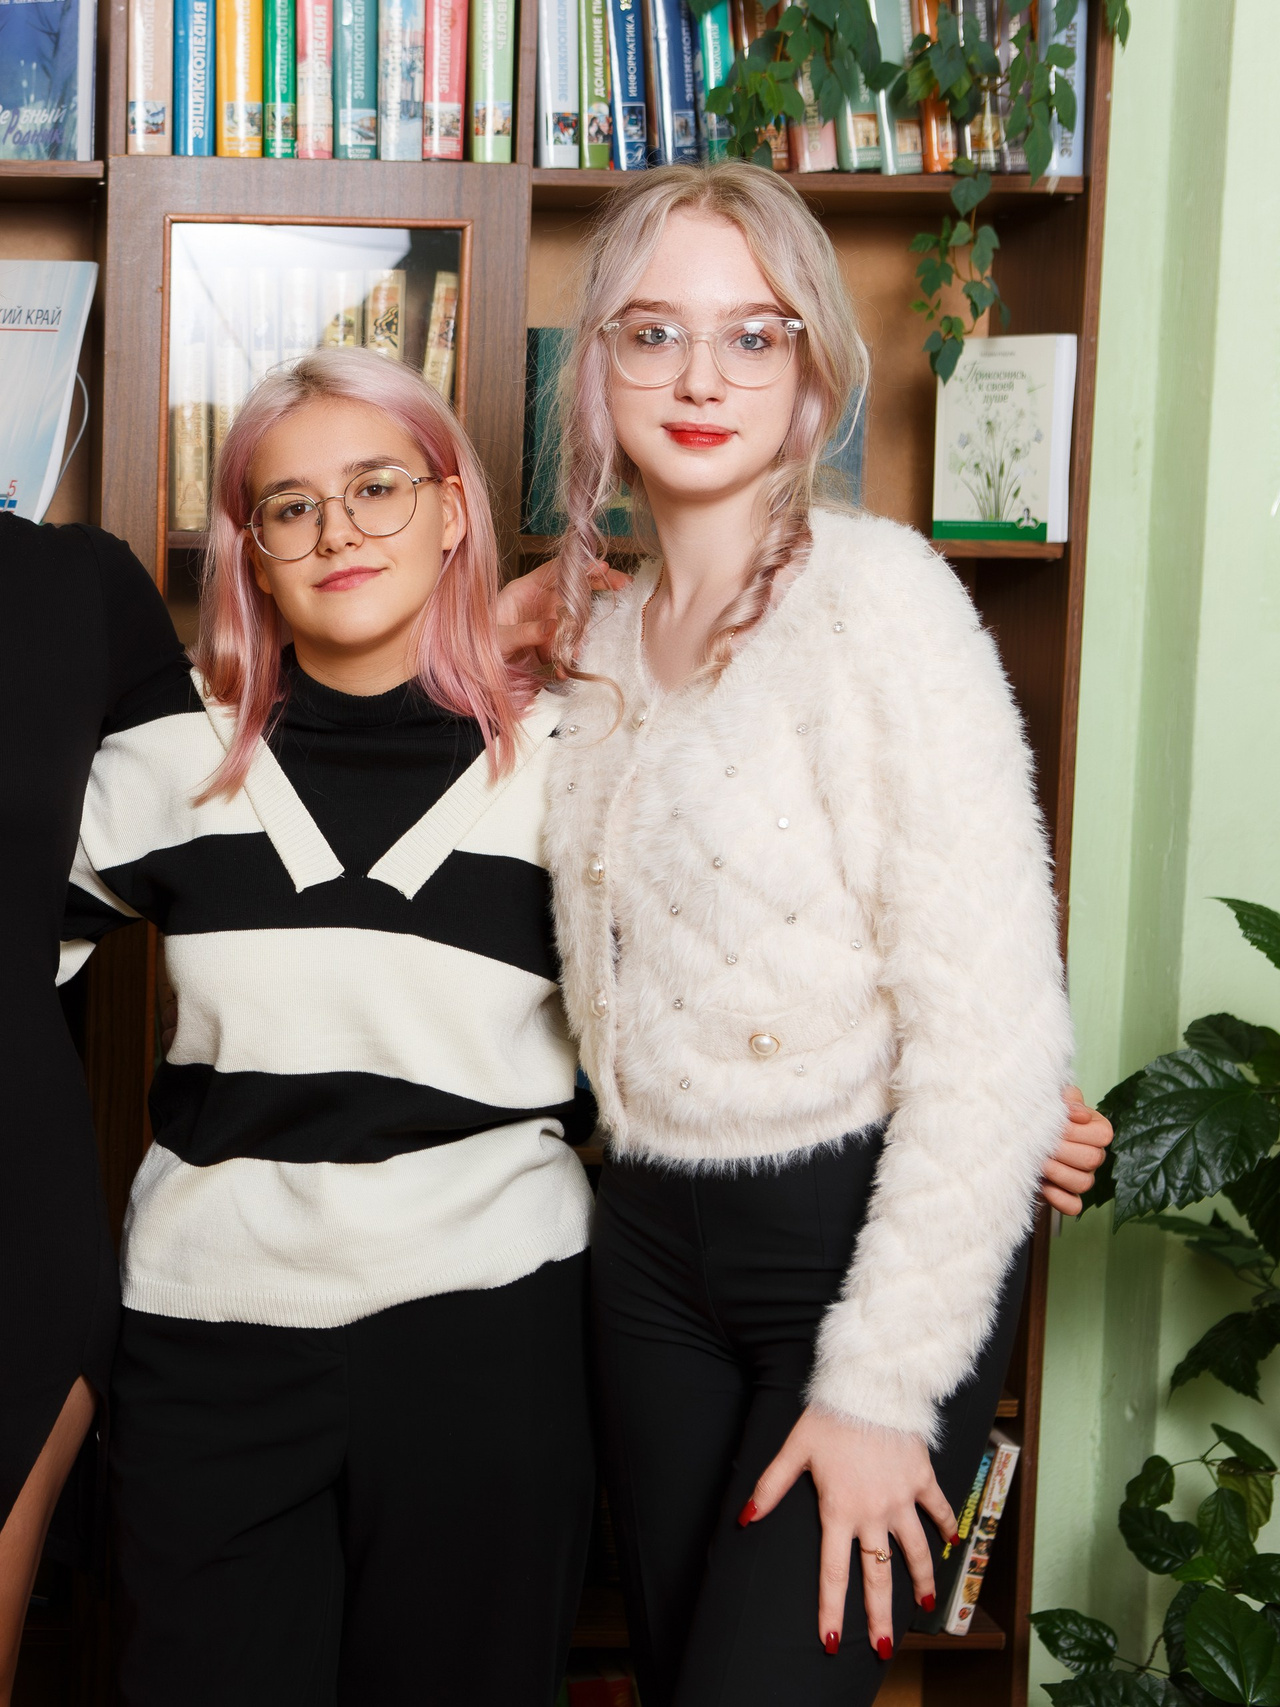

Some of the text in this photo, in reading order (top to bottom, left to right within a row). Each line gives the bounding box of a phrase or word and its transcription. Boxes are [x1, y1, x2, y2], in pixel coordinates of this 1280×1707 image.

[193, 1, 207, 139] ЭНЦИКЛОПЕДИЯ
[594, 13, 605, 98] ДОМАШНИЕ
[625, 13, 638, 98] ИНФОРМАТИКА
[25, 306, 62, 326] КРАЙ
[7, 480, 17, 497] 5
